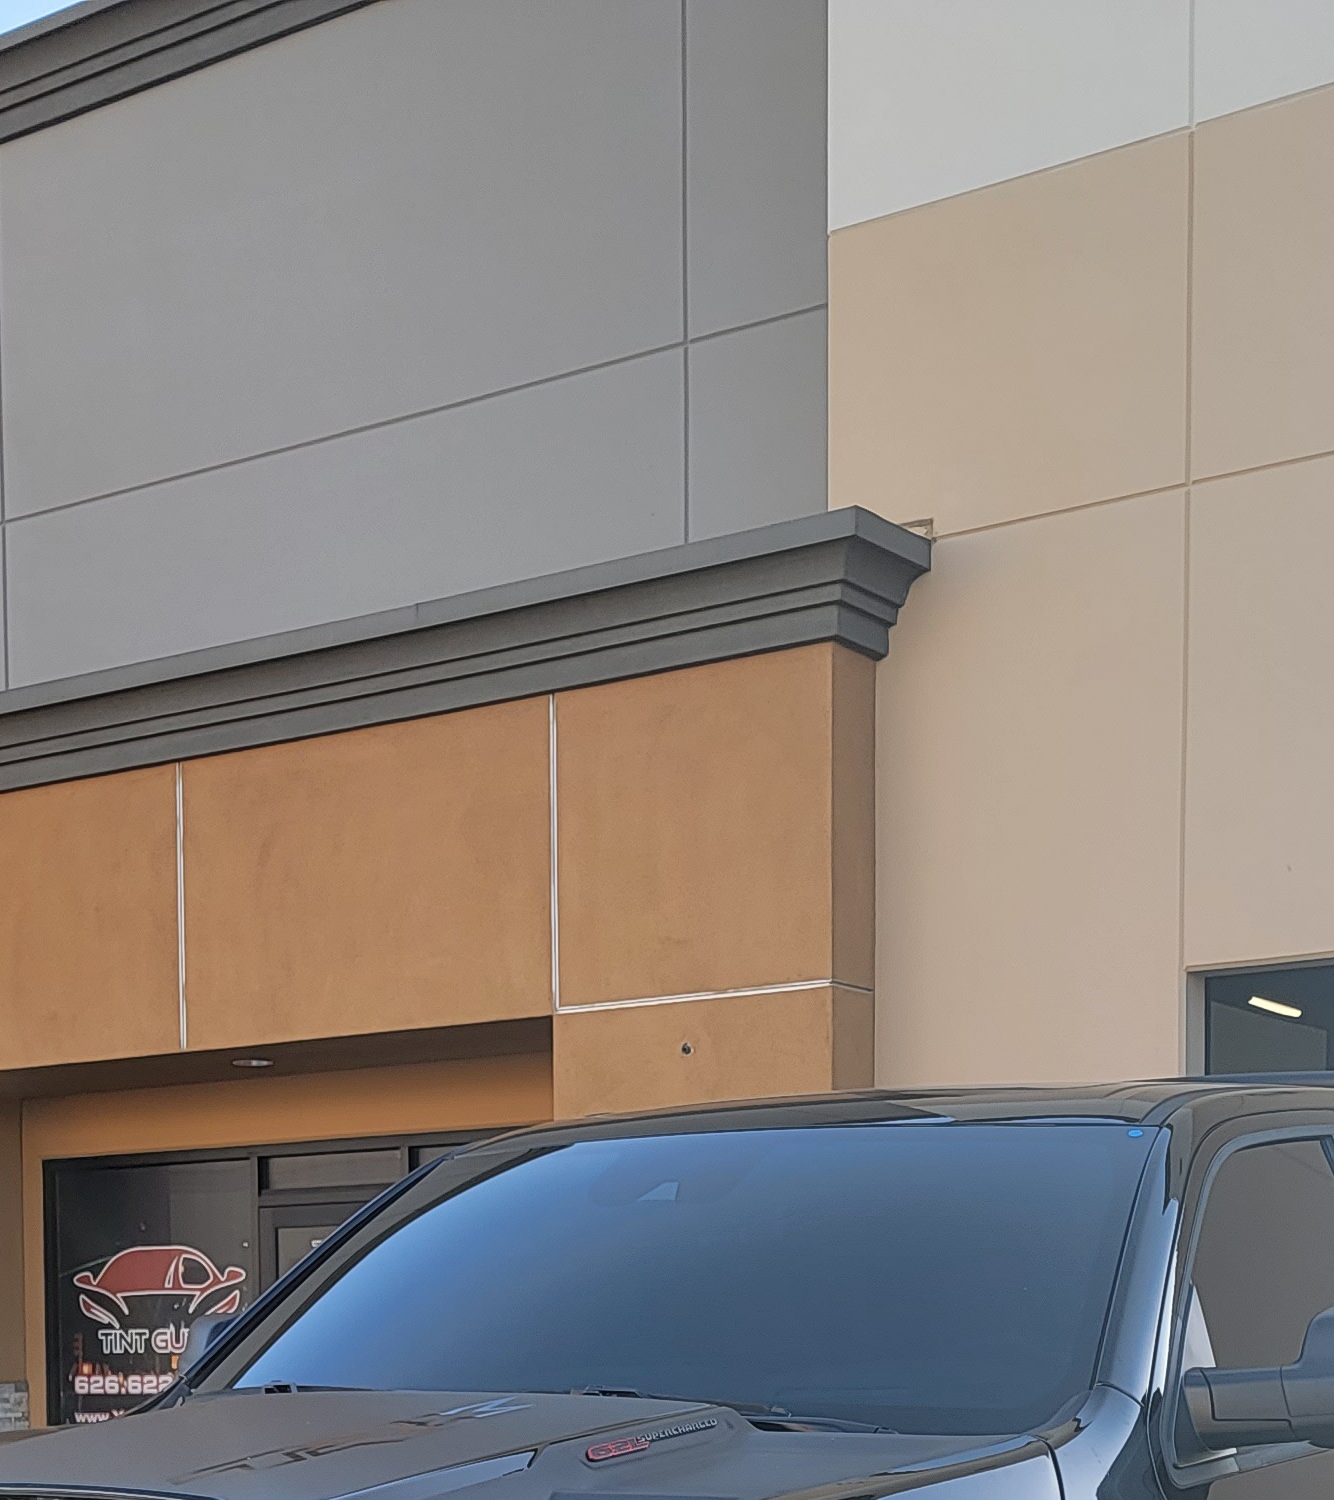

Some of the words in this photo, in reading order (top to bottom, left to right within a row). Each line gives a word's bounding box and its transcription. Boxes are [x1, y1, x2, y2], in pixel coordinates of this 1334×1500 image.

[98, 1328, 149, 1354] TINT
[151, 1322, 189, 1353] GU
[637, 1419, 717, 1443] SUPERCHARGED
